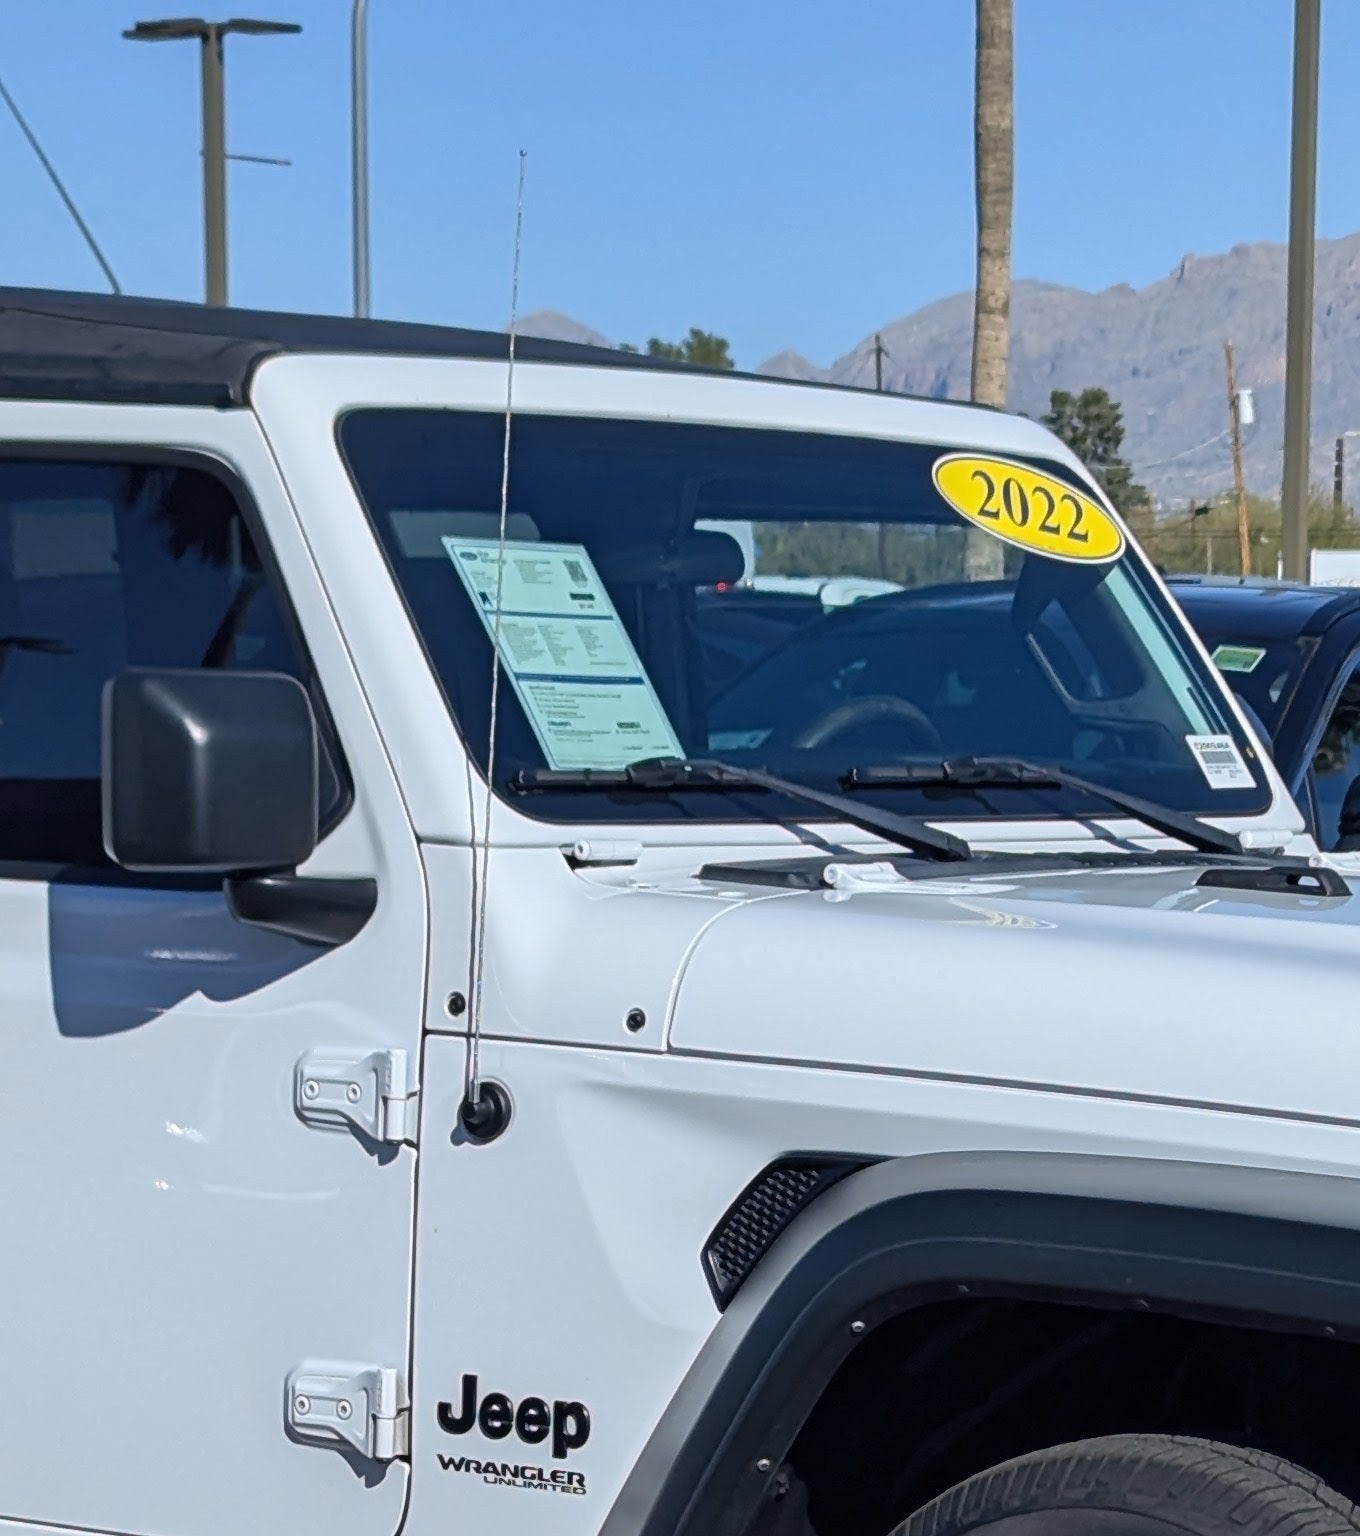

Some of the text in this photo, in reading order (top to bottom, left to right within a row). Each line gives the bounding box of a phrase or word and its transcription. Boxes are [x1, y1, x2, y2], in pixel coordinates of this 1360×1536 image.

[971, 470, 1089, 543] 2022
[437, 1374, 590, 1459] Jeep
[437, 1453, 586, 1487] WRANGLER
[483, 1475, 587, 1495] UNLIMITED
